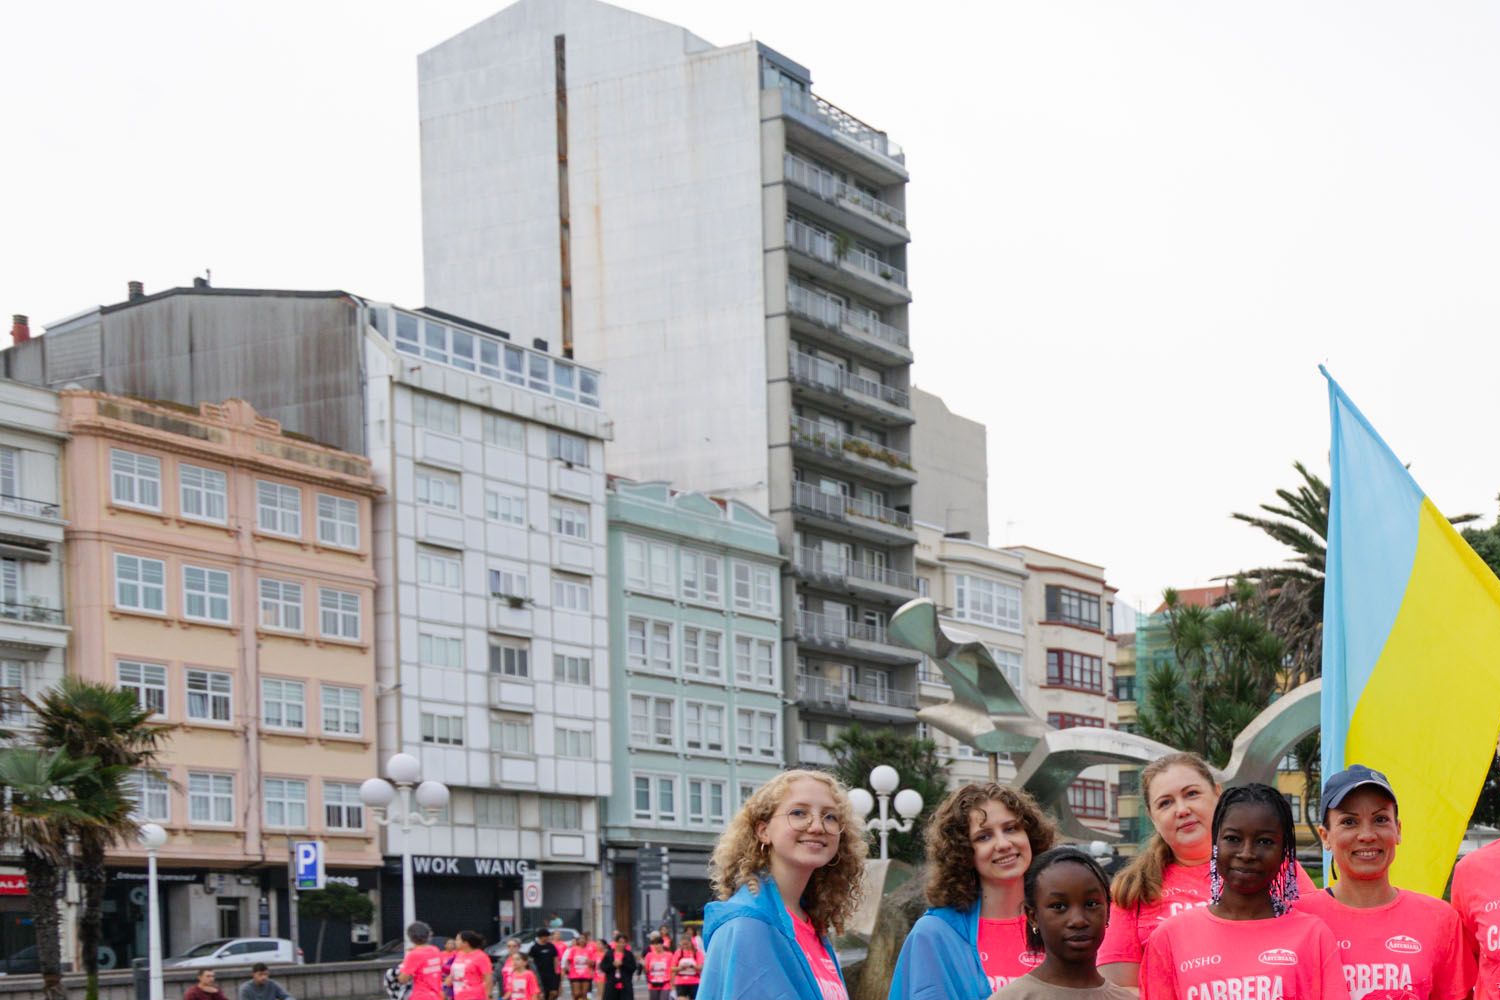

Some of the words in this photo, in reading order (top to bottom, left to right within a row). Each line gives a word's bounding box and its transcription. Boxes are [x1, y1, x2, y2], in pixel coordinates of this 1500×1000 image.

[299, 844, 316, 875] P
[413, 857, 459, 874] WOK
[474, 858, 529, 876] WANG
[1180, 954, 1222, 973] OYSHO
